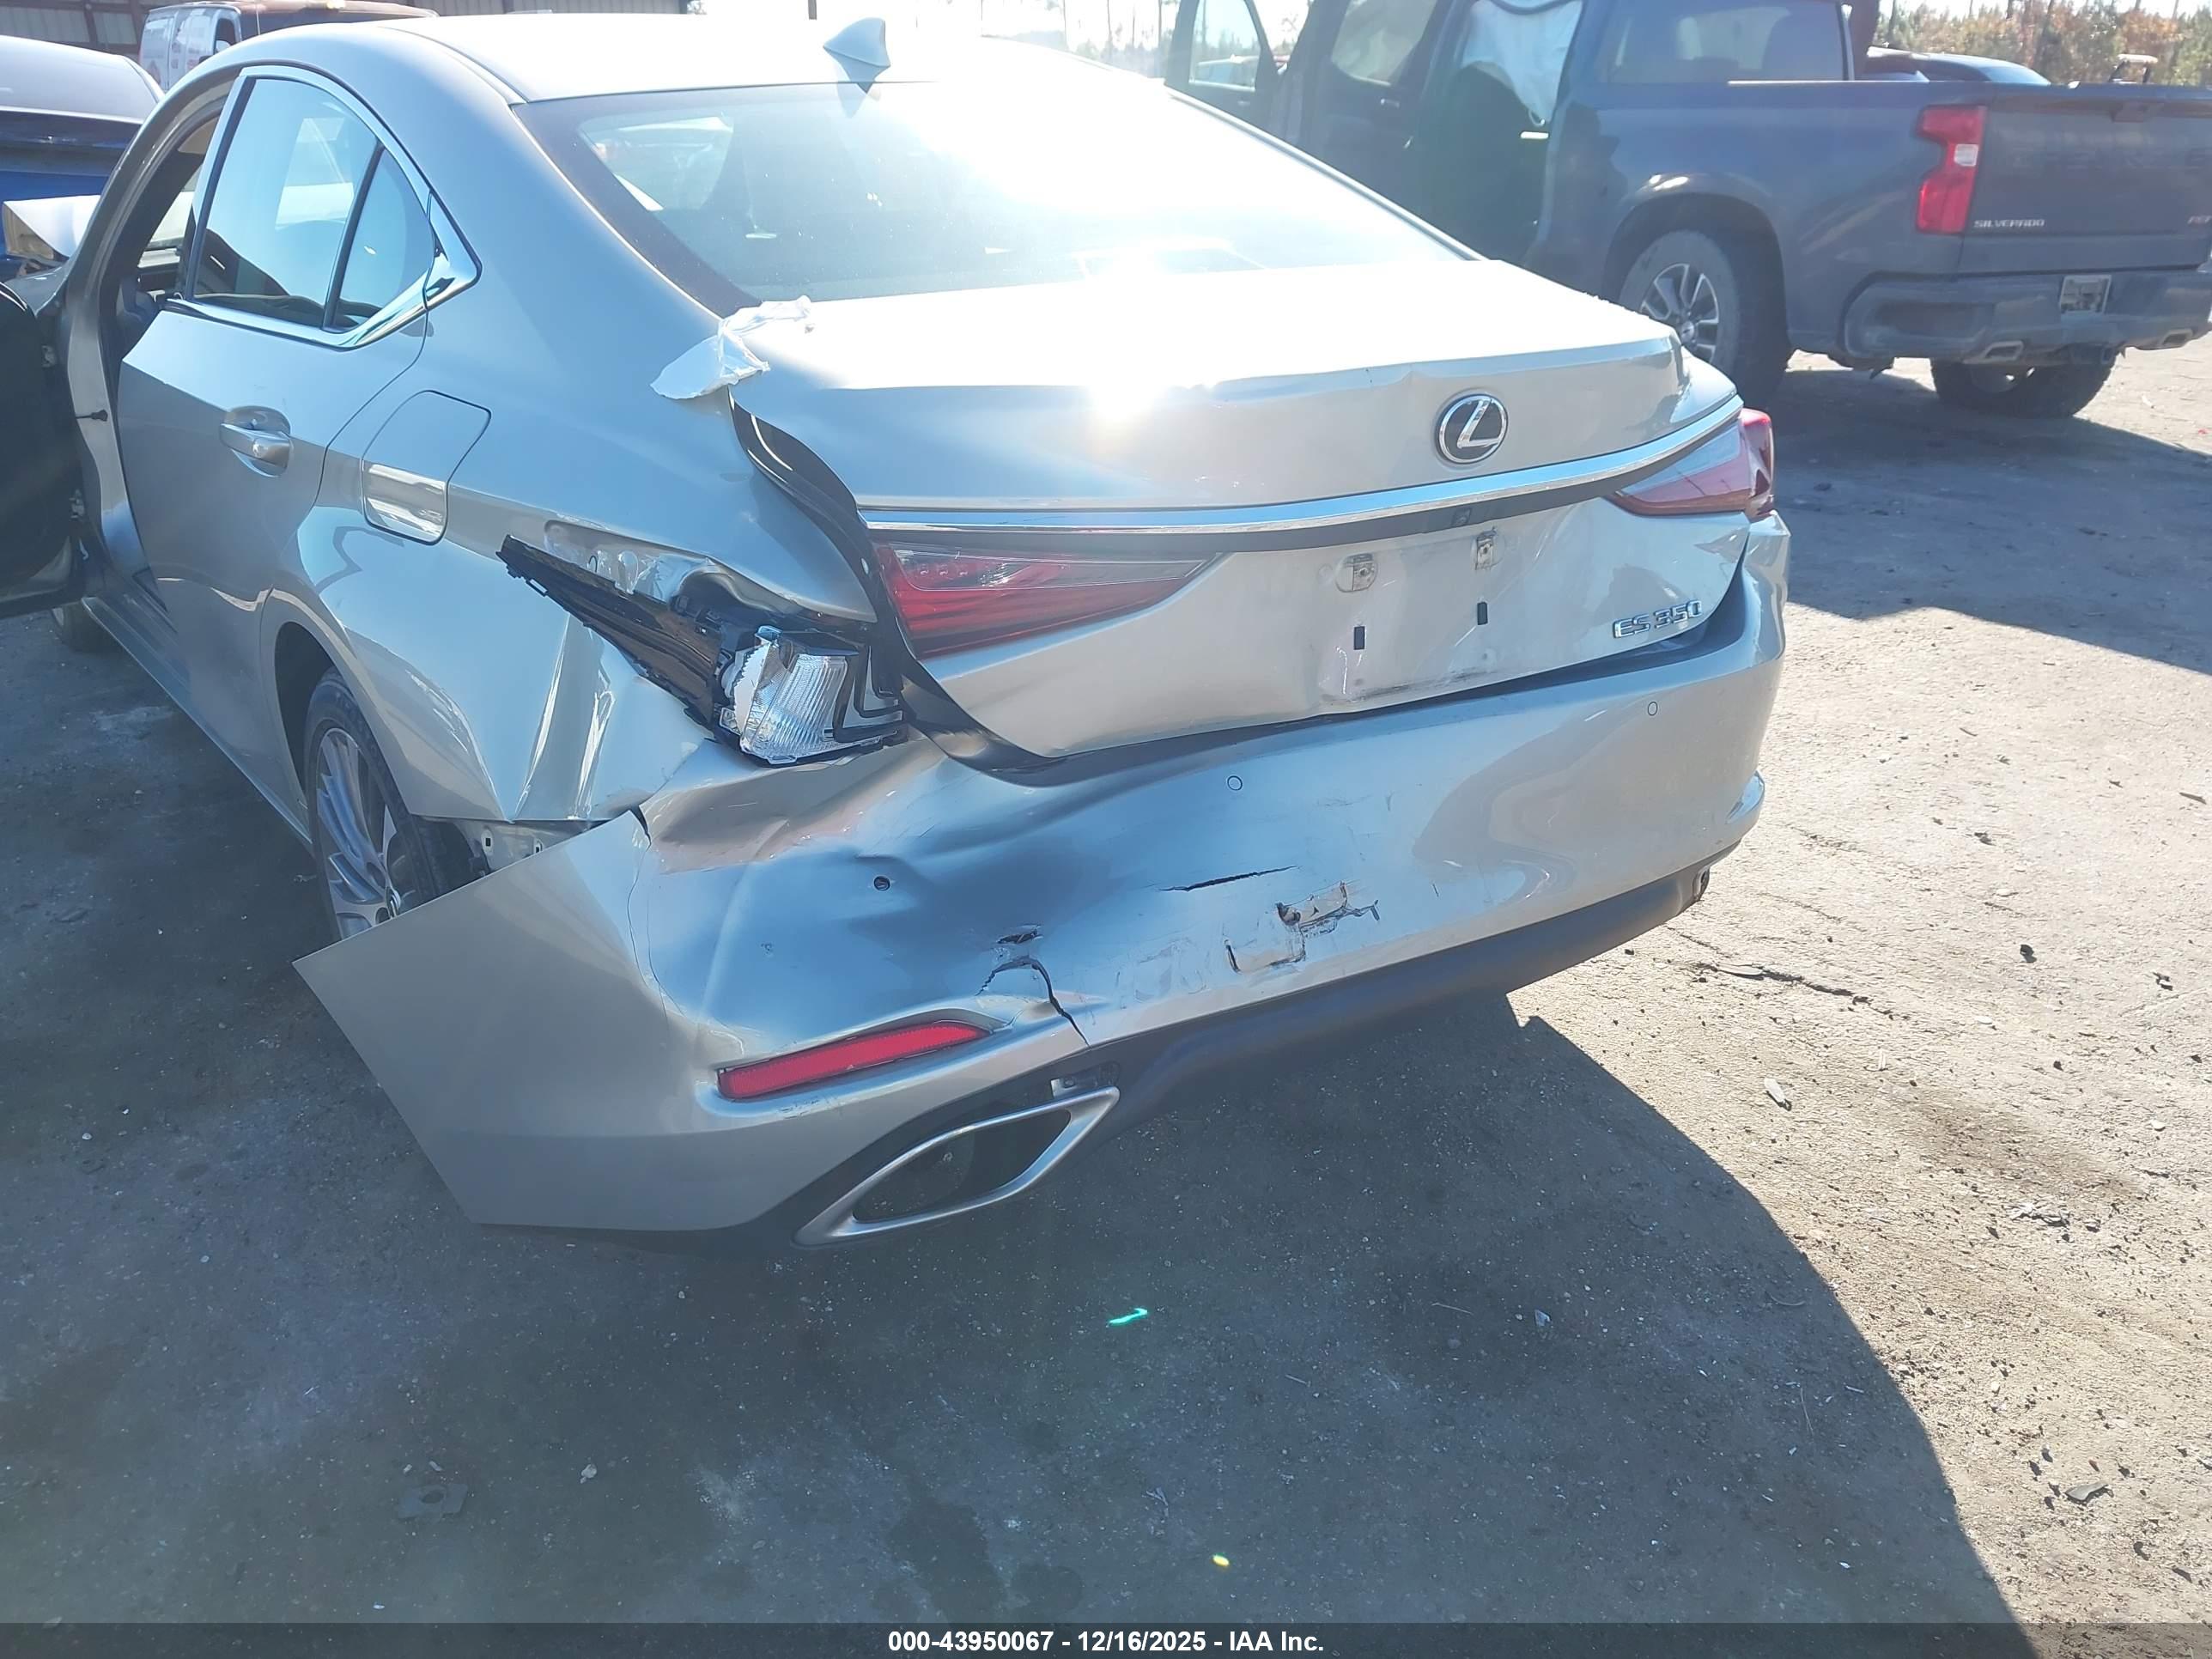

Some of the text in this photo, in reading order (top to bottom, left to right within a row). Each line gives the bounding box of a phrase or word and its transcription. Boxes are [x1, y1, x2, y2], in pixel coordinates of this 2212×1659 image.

[1973, 218, 2046, 228] SILVERADO
[1613, 599, 1702, 638] ES 350
